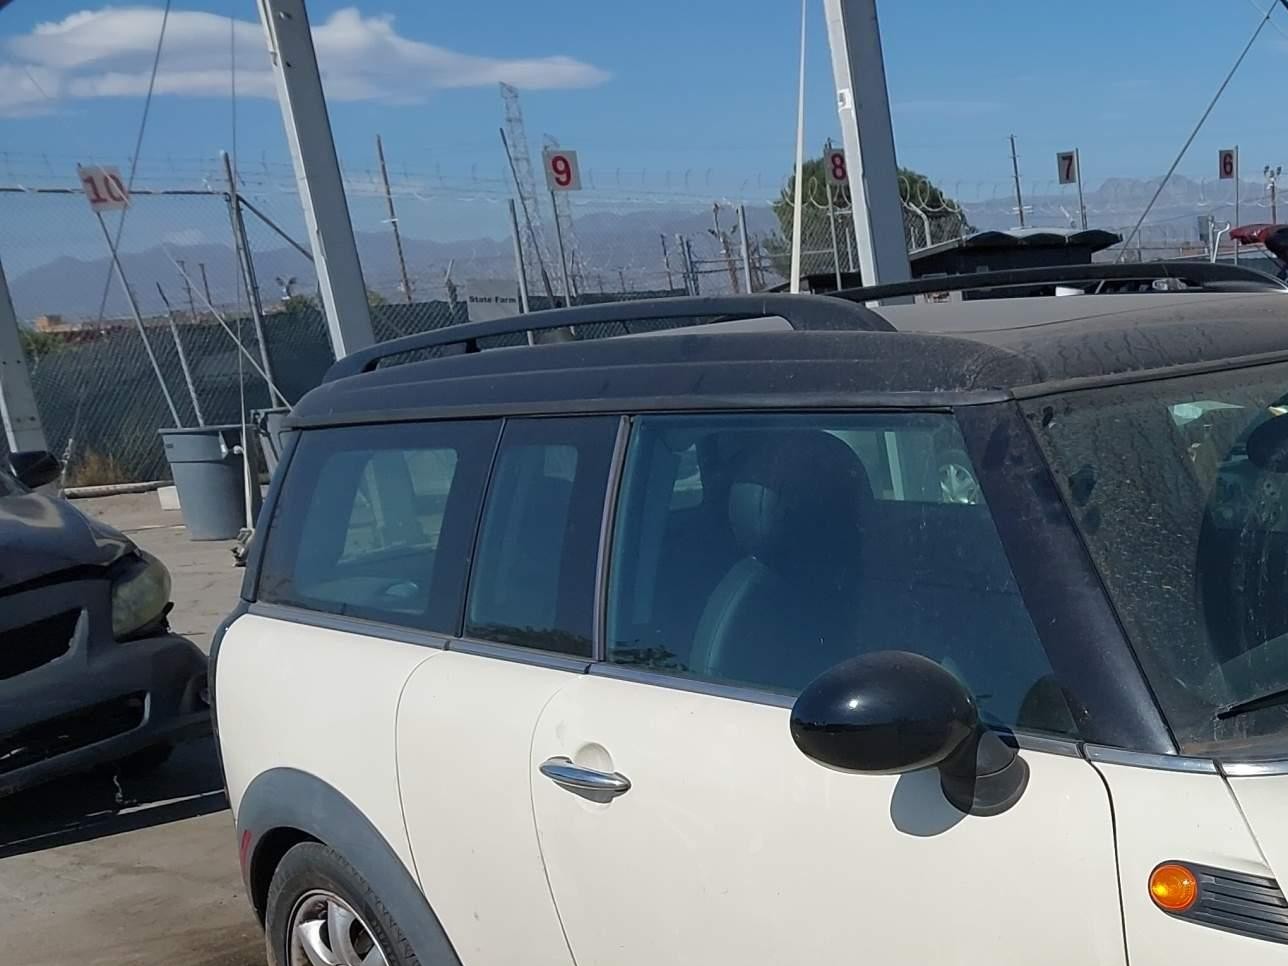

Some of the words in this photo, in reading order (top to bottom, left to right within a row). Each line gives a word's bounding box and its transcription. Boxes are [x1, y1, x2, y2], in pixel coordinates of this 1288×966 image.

[551, 155, 571, 186] 9
[831, 153, 847, 180] 8
[1061, 155, 1073, 180] 7
[1223, 153, 1234, 175] 6
[83, 174, 128, 203] 10
[469, 295, 492, 304] State
[495, 295, 517, 304] Farm
